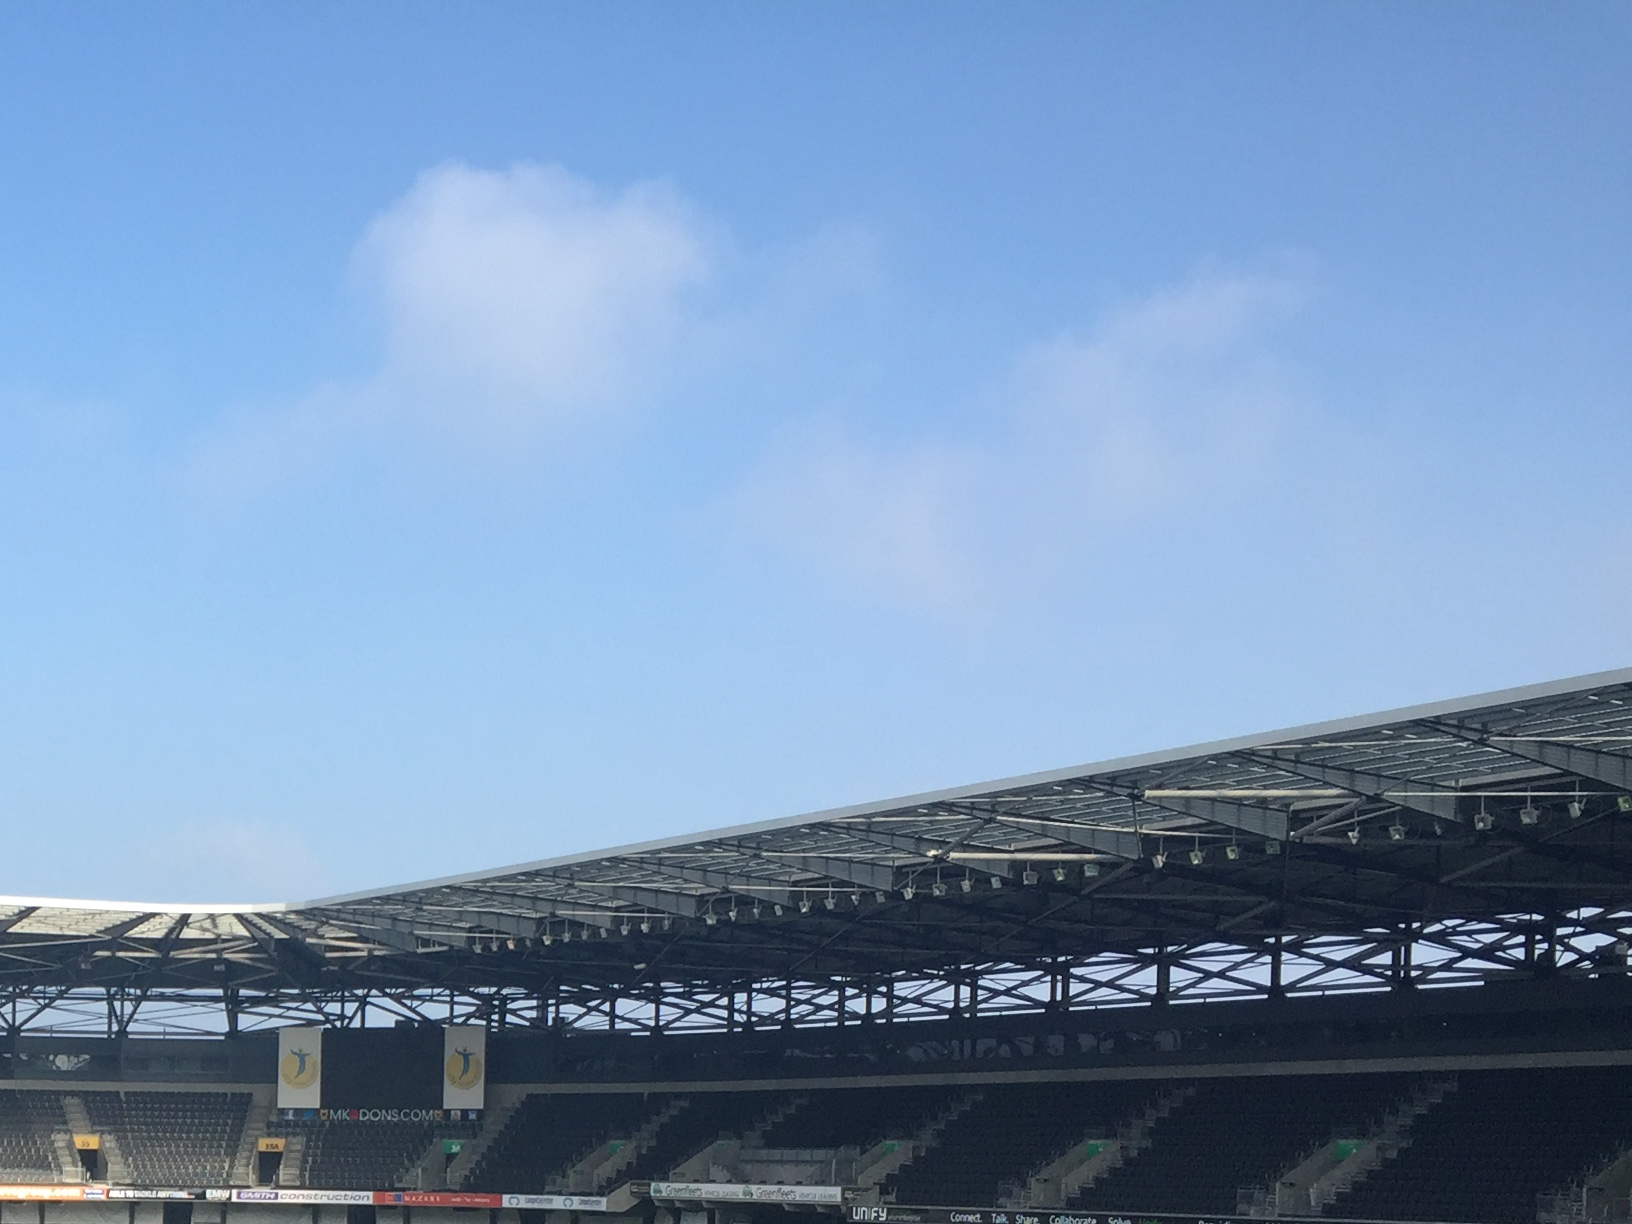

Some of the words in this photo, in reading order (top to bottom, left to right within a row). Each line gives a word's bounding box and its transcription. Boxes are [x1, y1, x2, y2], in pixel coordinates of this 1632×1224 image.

[329, 1109, 349, 1121] MK
[239, 1191, 276, 1200] SMITH
[280, 1191, 370, 1201] construction
[665, 1185, 703, 1197] Greenfleets
[755, 1187, 796, 1200] Greenfleets
